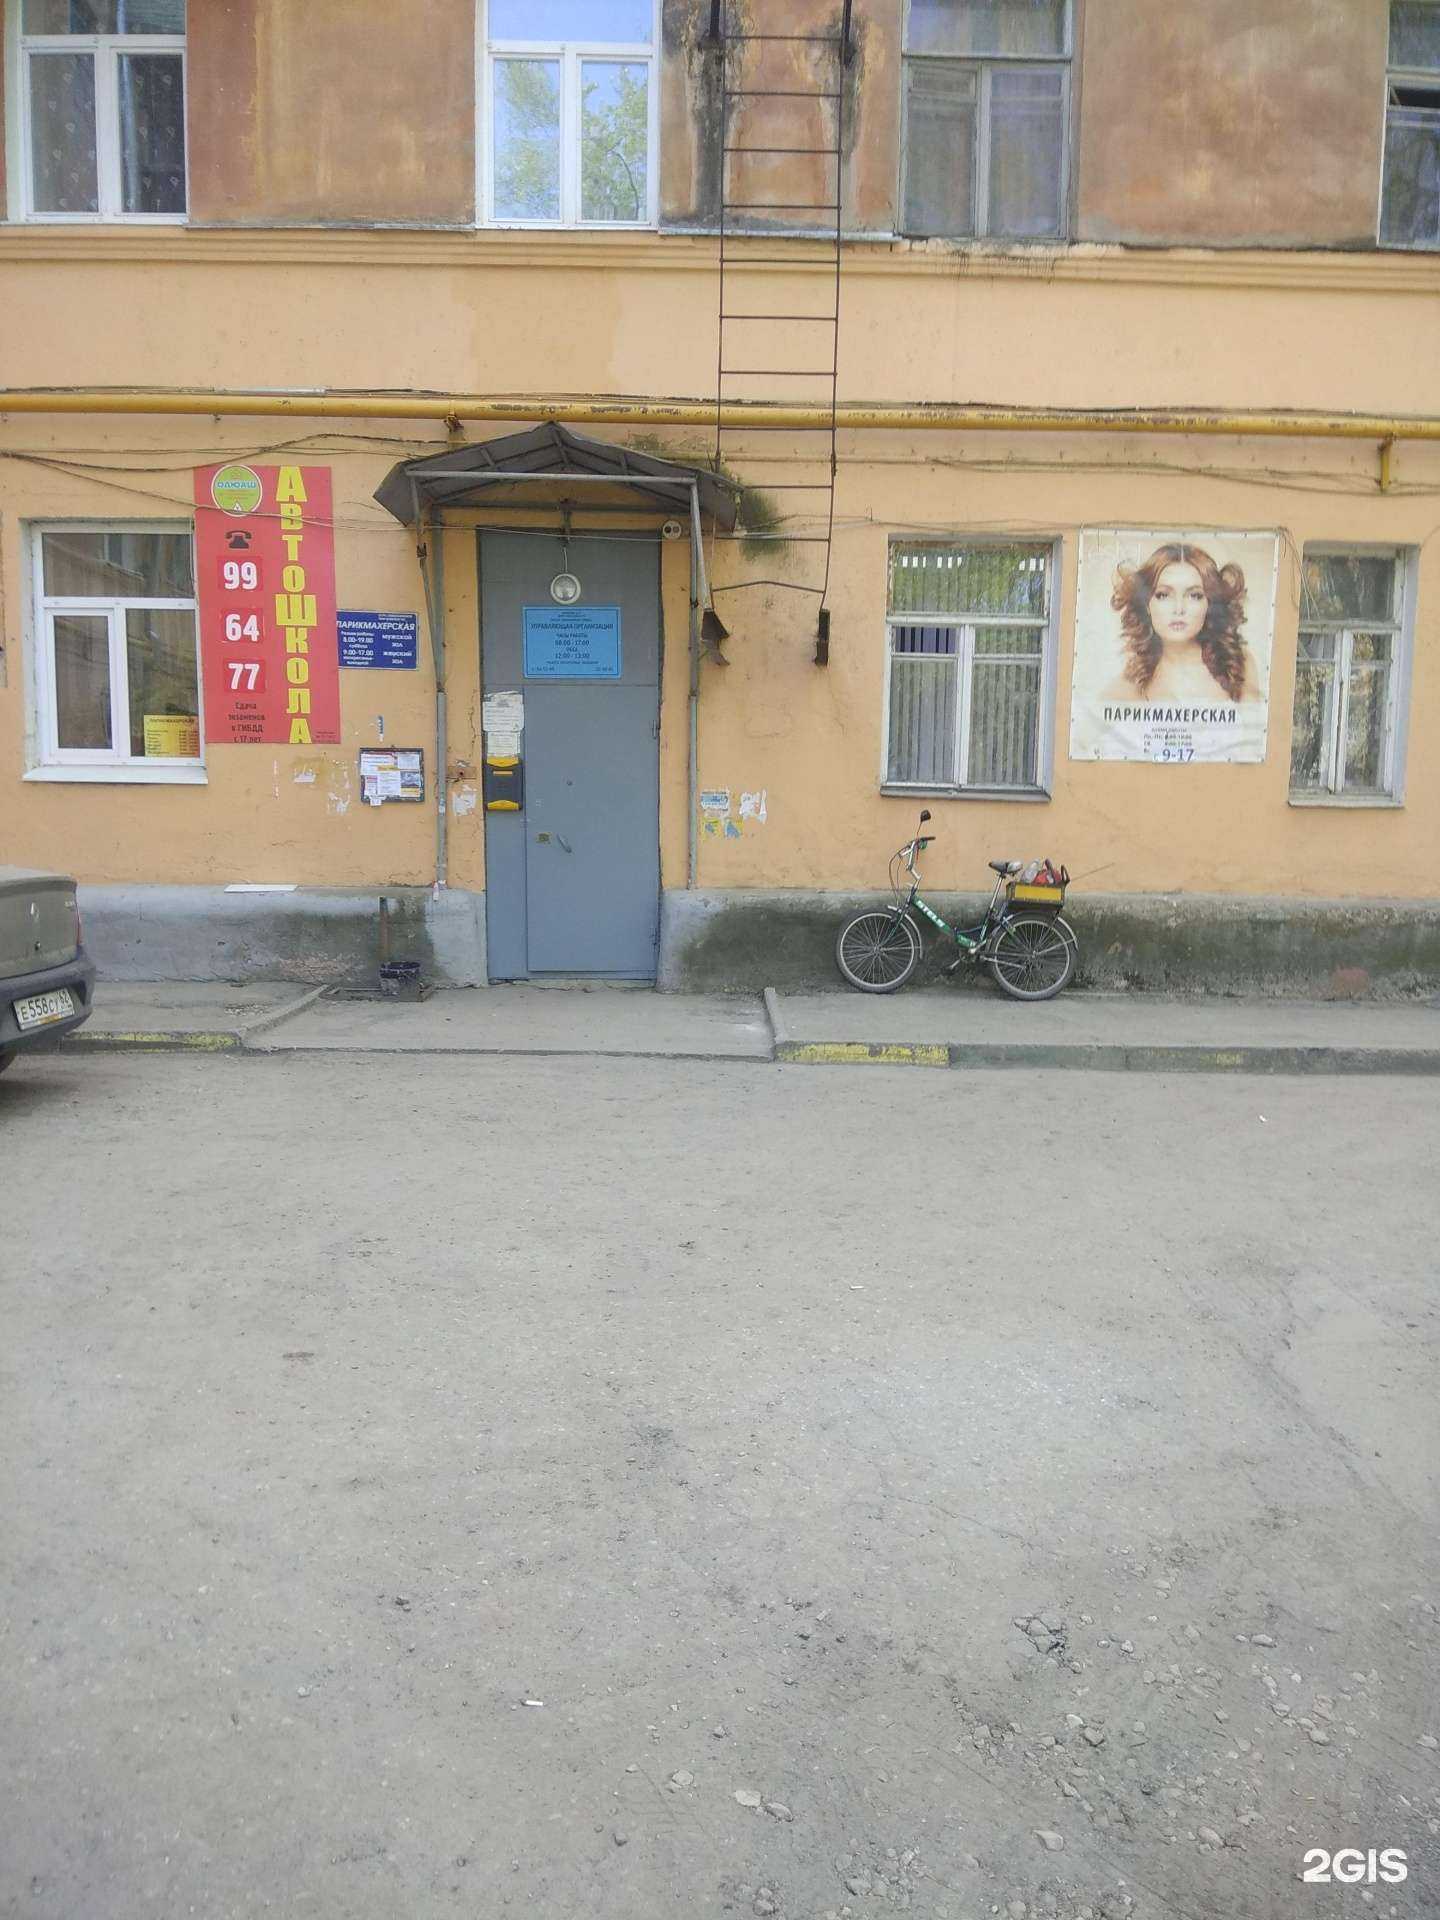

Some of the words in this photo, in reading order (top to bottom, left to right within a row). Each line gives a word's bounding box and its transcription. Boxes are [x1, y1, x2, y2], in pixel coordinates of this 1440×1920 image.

[223, 561, 258, 590] 99
[276, 466, 317, 744] АВТОШКОЛА
[225, 613, 260, 642] 64
[336, 620, 416, 631] ПАРИКМАХЕРСКАЯ
[228, 663, 260, 690] 77
[1104, 707, 1236, 723] ПАРИКМАХЕРСКАЯ
